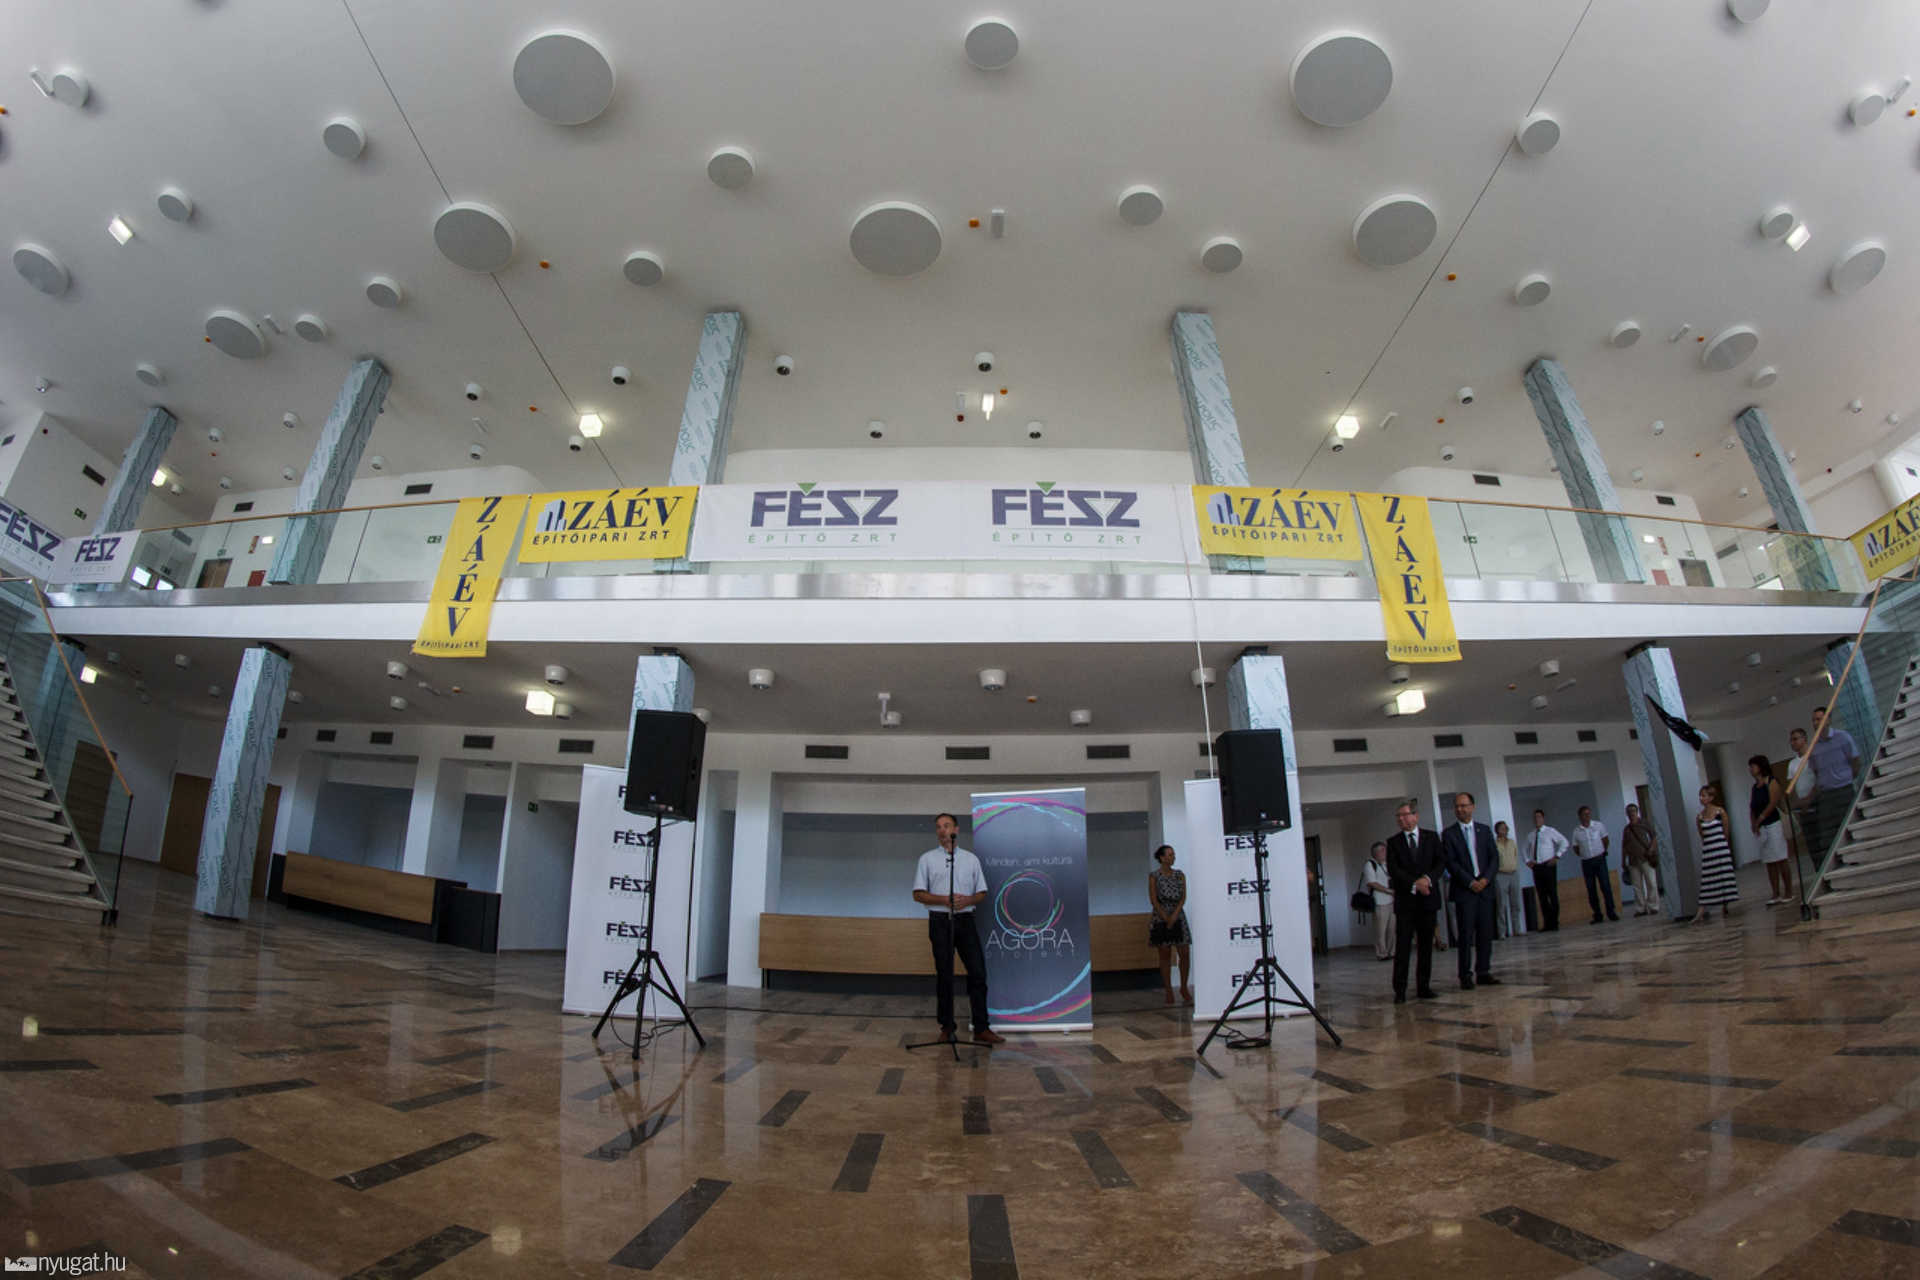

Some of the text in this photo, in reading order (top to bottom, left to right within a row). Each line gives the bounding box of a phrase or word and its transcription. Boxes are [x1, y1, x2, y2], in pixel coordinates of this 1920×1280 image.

[567, 488, 684, 531] ZÁÉV
[1240, 489, 1342, 531] ZÁÉV
[638, 530, 670, 541] ZRT
[850, 532, 896, 543] ZRT
[1098, 534, 1142, 544] ZRT
[1318, 533, 1344, 543] ZRT
